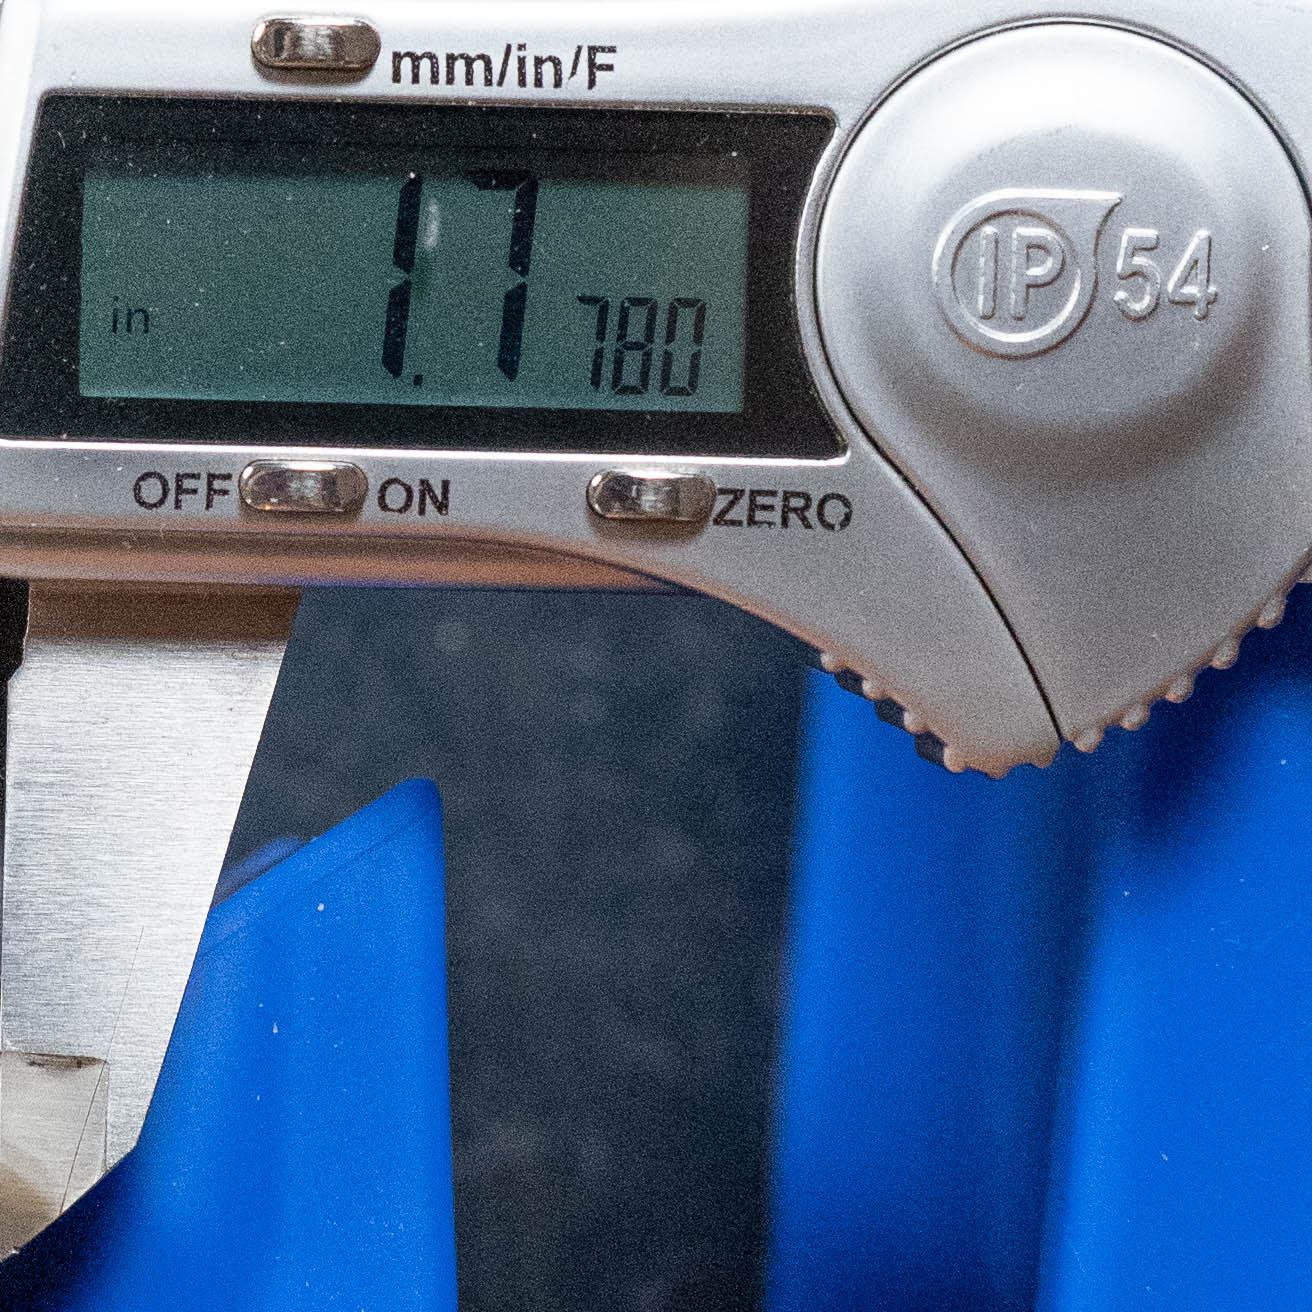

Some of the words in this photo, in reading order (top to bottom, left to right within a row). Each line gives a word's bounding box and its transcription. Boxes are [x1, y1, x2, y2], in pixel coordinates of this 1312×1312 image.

[390, 42, 618, 91] mm/in/F
[978, 225, 1067, 321] IP
[1113, 227, 1219, 323] 54
[108, 295, 153, 335] in
[131, 468, 234, 512] OFF
[376, 475, 453, 518] ON
[711, 485, 855, 532] ZERO
